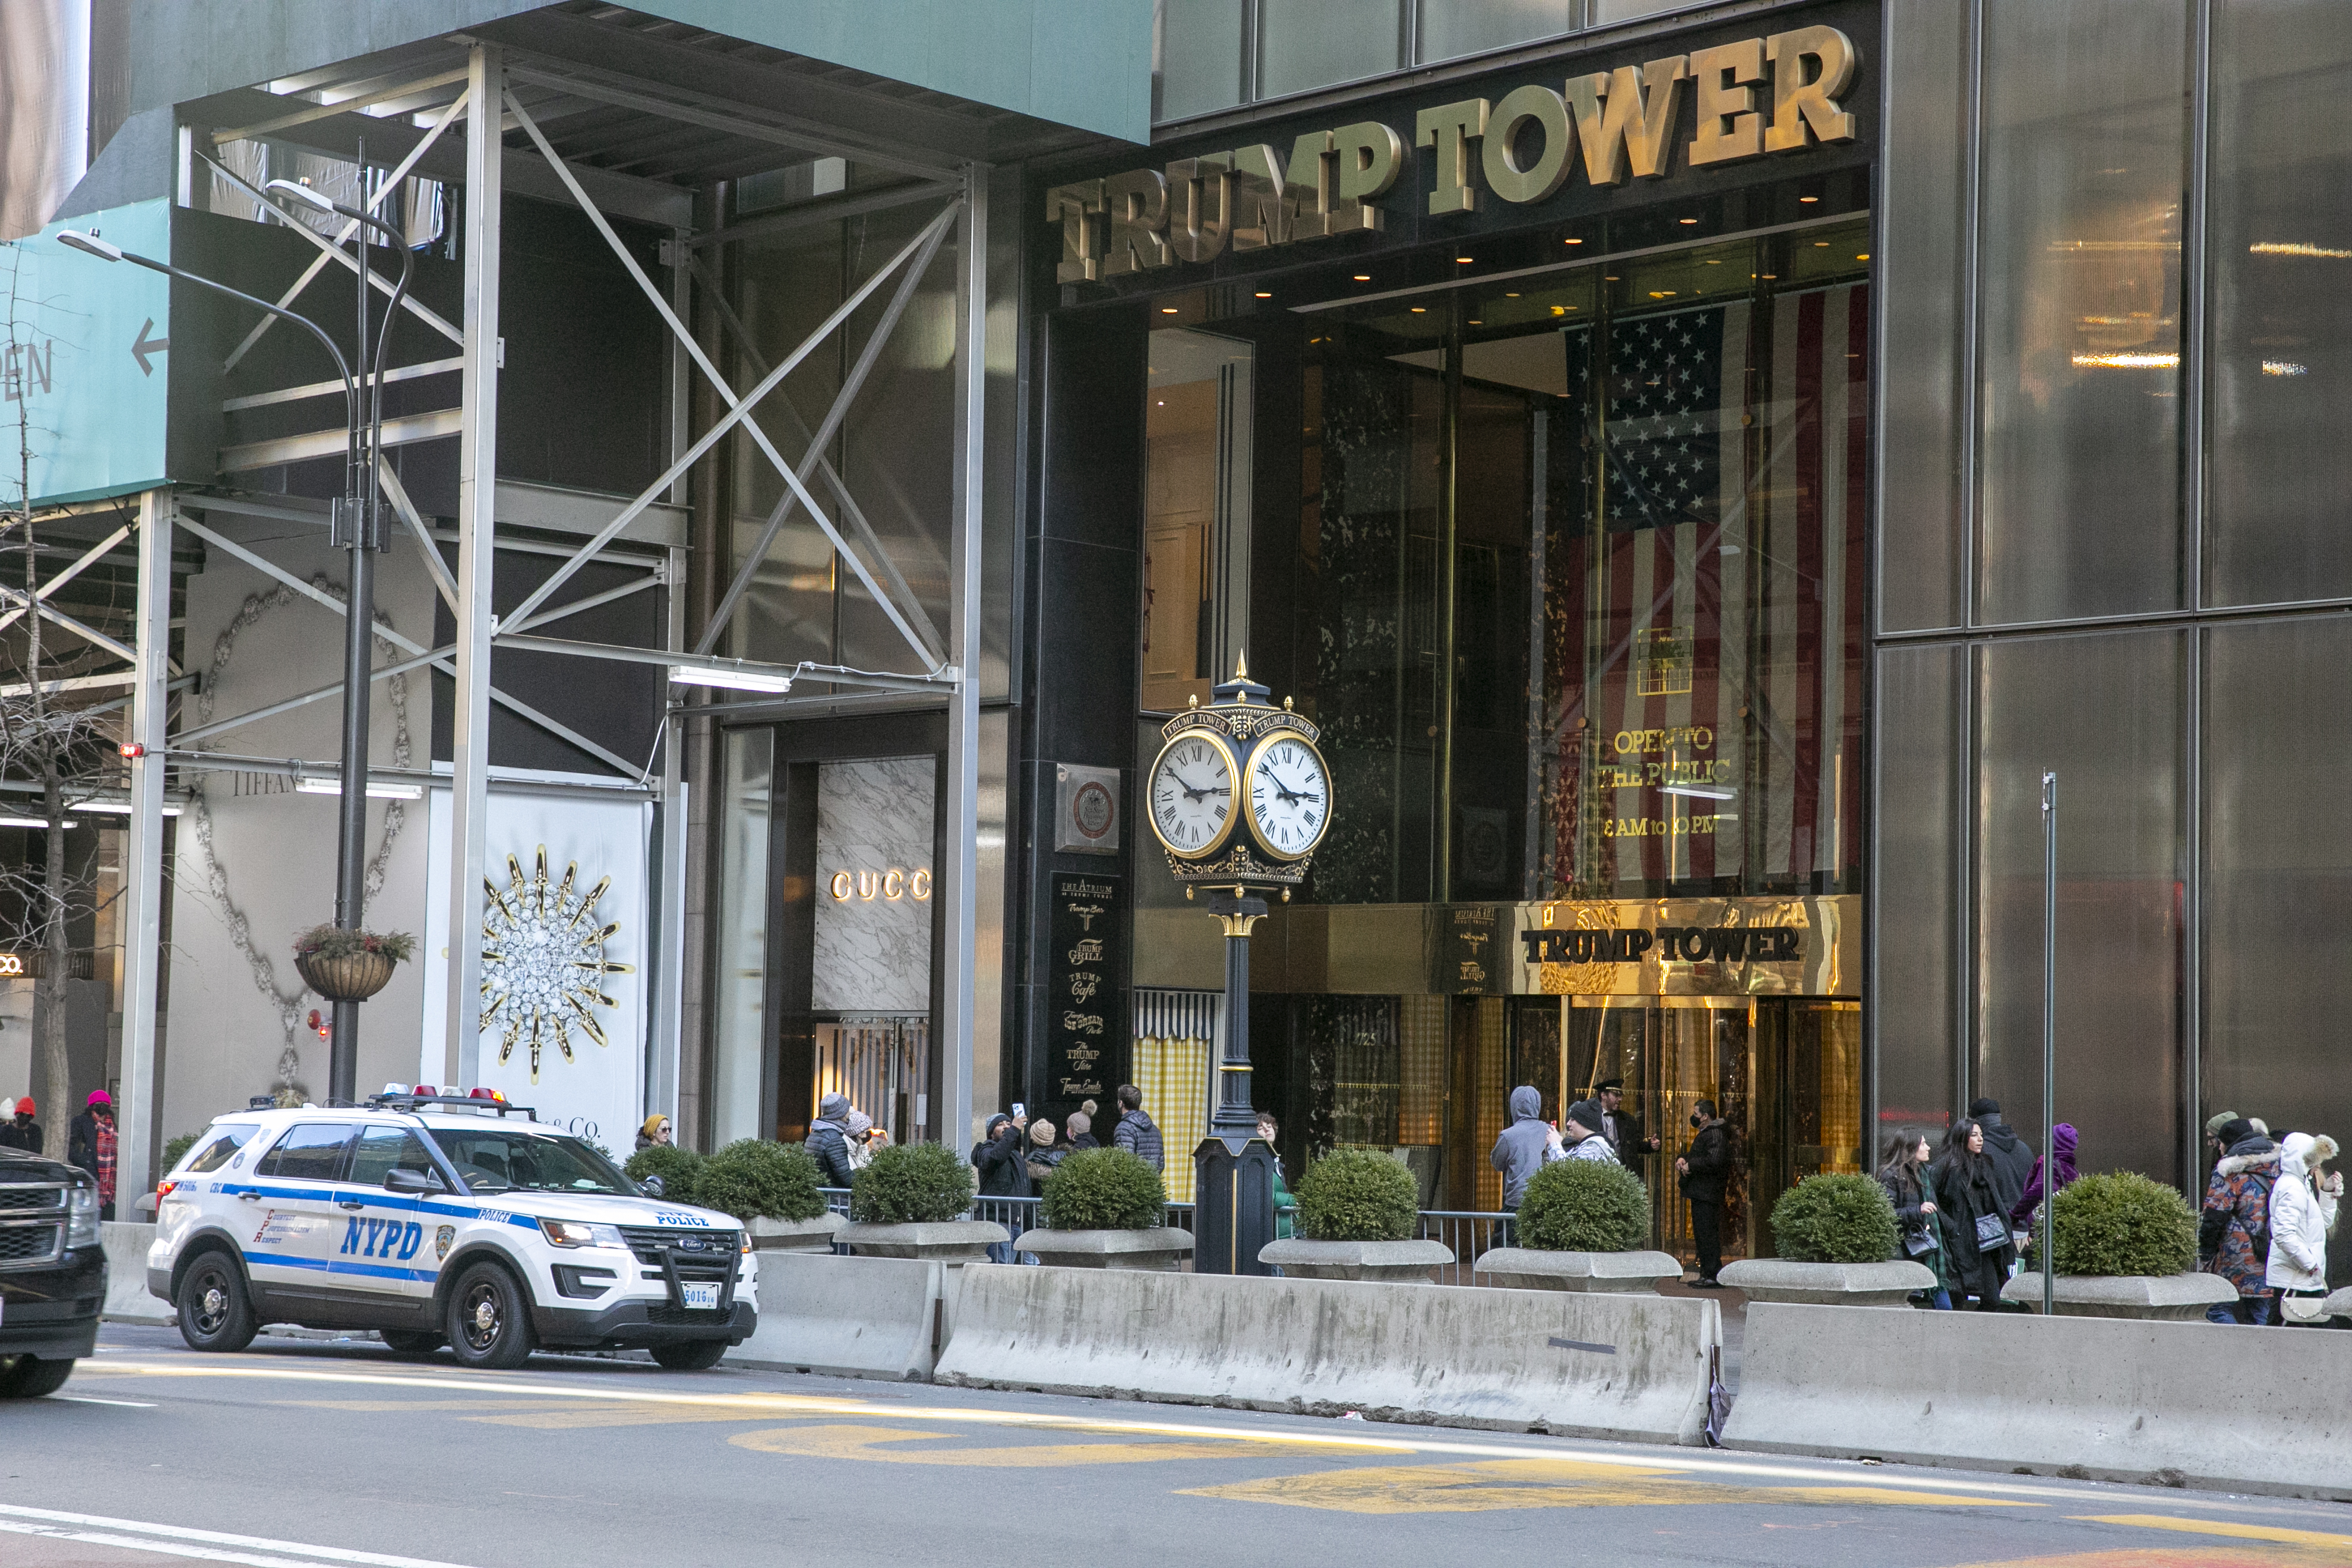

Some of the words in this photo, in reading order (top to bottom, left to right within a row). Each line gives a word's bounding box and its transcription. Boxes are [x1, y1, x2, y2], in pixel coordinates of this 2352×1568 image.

[1046, 121, 1402, 284] TRUMP
[1416, 24, 1856, 216] TOWER
[0, 339, 52, 402] EN
[1166, 715, 1195, 735] TRUMP
[1197, 714, 1226, 732] TOWER
[1257, 716, 1286, 732] TRUMP
[1289, 716, 1316, 738] TOWER
[1598, 764, 1643, 788] THE
[1647, 759, 1730, 786] PUBLIC
[1615, 818, 1648, 836] AM
[1651, 820, 1667, 835] to
[1691, 815, 1718, 834] PM
[830, 871, 931, 899] GUCC
[1079, 879, 1112, 893] ATRIUM
[1068, 903, 1090, 913] Trump
[1090, 905, 1105, 913] Bar
[1077, 942, 1103, 953] TRUMP
[1520, 928, 1654, 964] TRUMP
[1655, 926, 1800, 962] TOWER
[1068, 950, 1103, 962] GRILL
[1069, 972, 1102, 984] TRUMP
[1071, 981, 1096, 1004] Café
[1064, 1018, 1076, 1030] ICE
[1077, 1015, 1104, 1029] CREAM
[1075, 1041, 1088, 1050] The
[1066, 1049, 1100, 1060] TRUMP
[1060, 1078, 1082, 1095] Trump
[479, 1209, 510, 1223] POLICE
[655, 1216, 710, 1227] POLICE
[340, 1216, 422, 1260] NYPD
[686, 1240, 701, 1248] Ford
[685, 1290, 707, 1303] 5016
